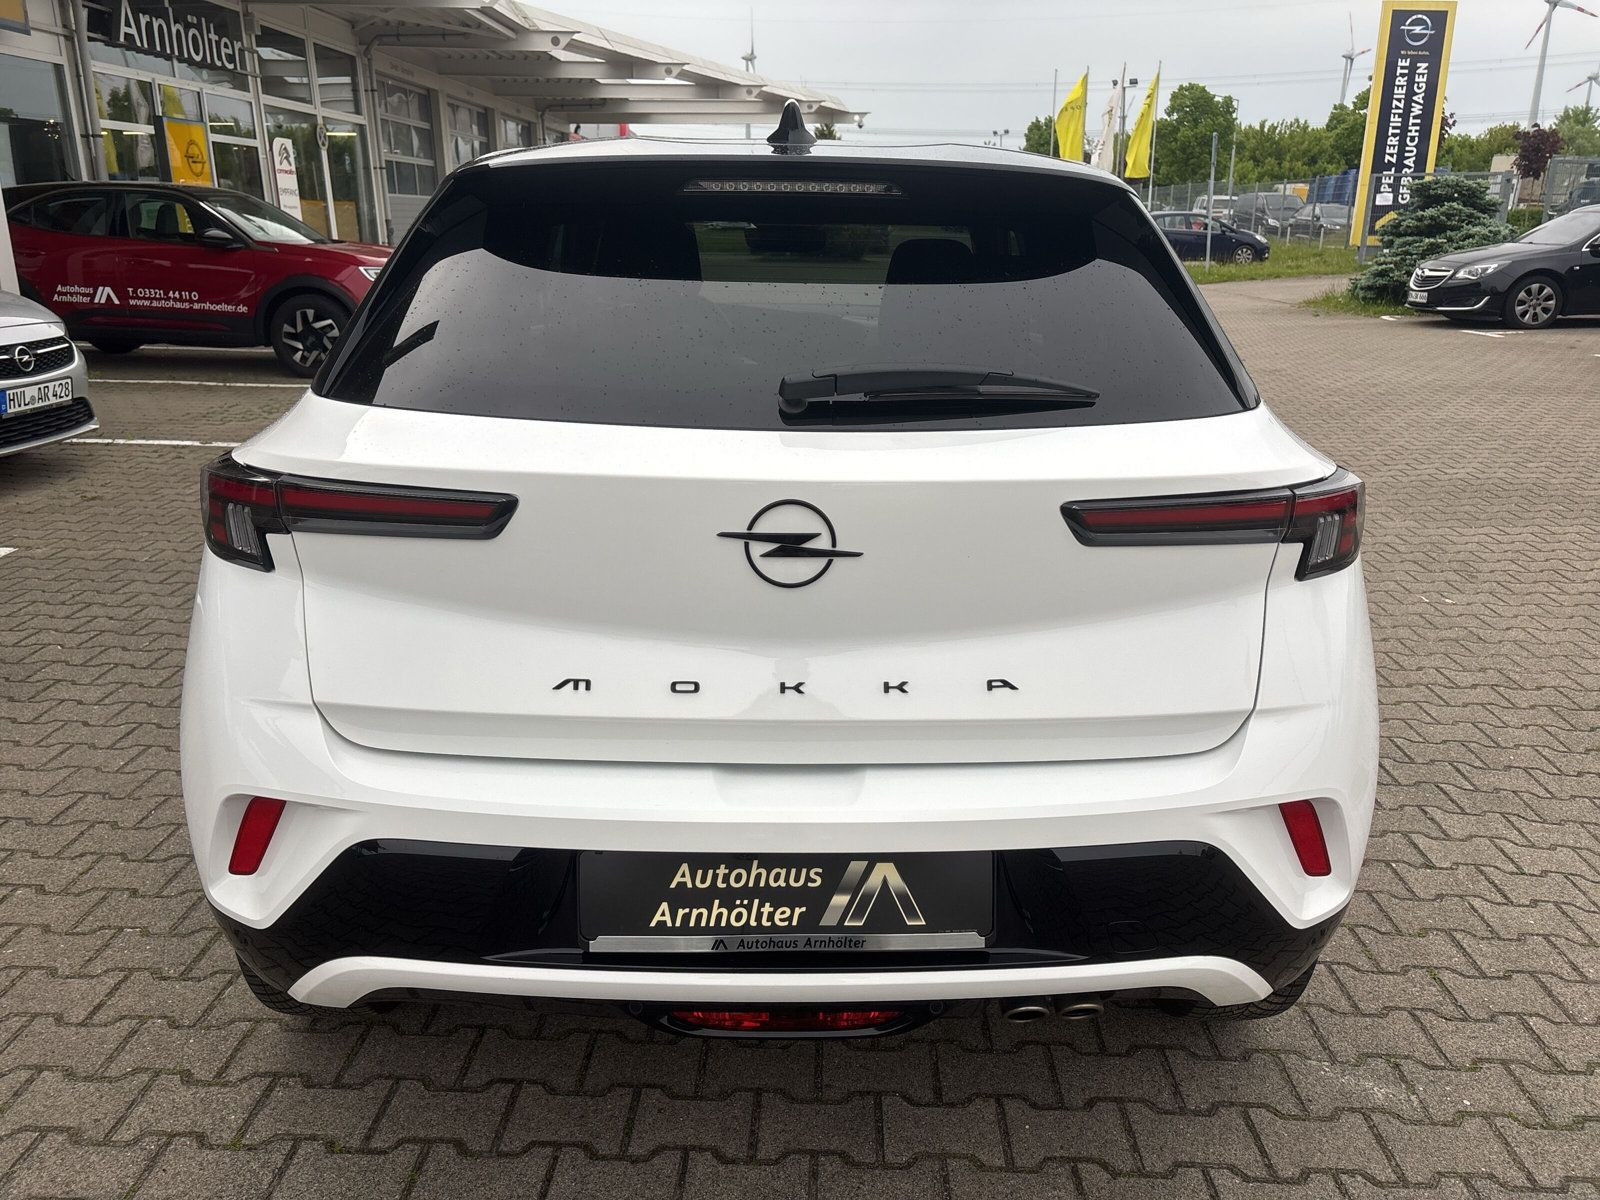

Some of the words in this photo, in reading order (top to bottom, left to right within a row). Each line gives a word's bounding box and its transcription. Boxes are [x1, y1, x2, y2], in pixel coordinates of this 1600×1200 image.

[120, 0, 241, 71] Arnhölter
[1384, 58, 1411, 164] ZERTIFIZIERTE
[1398, 62, 1429, 205] GEBRAUCHTWAGEN
[1379, 167, 1395, 194] PEL
[53, 293, 91, 303] Arnhölter
[56, 284, 94, 293] Autohaus
[127, 288, 136, 297] T.
[137, 288, 167, 299] 03321.
[168, 290, 179, 299] 44
[181, 291, 190, 300] 11
[191, 291, 199, 300] 0
[129, 299, 249, 313] www.autohaus-arnhoelter.de
[8, 390, 30, 409] HVL
[37, 385, 51, 404] AR
[52, 381, 70, 400] 428
[552, 678, 1019, 694] MOKKA
[669, 859, 823, 889] Autohaus
[649, 899, 807, 927] Arnhölter
[736, 937, 799, 950] Autohaus
[803, 936, 867, 949] Arnhölter
